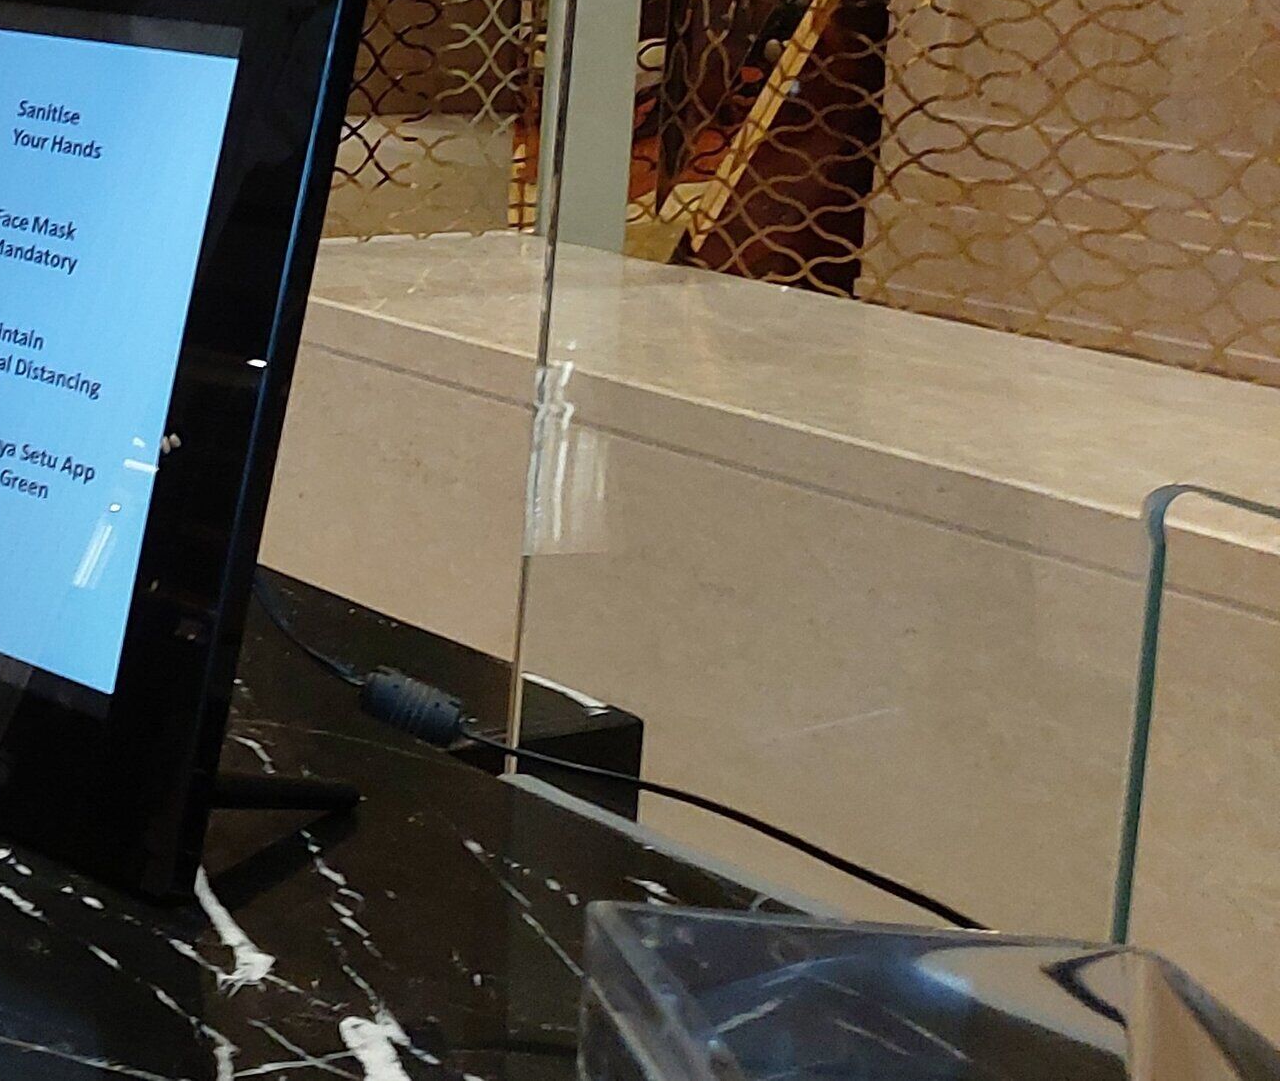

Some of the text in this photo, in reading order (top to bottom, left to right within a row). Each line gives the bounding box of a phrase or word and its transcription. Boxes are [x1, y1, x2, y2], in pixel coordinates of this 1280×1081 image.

[17, 100, 80, 125] Sanitise
[13, 128, 103, 159] Your Hands
[32, 216, 77, 240] Mask
[14, 358, 101, 400] Distancing
[20, 444, 58, 469] Setu
[60, 456, 95, 484] App
[0, 469, 49, 499] Green
